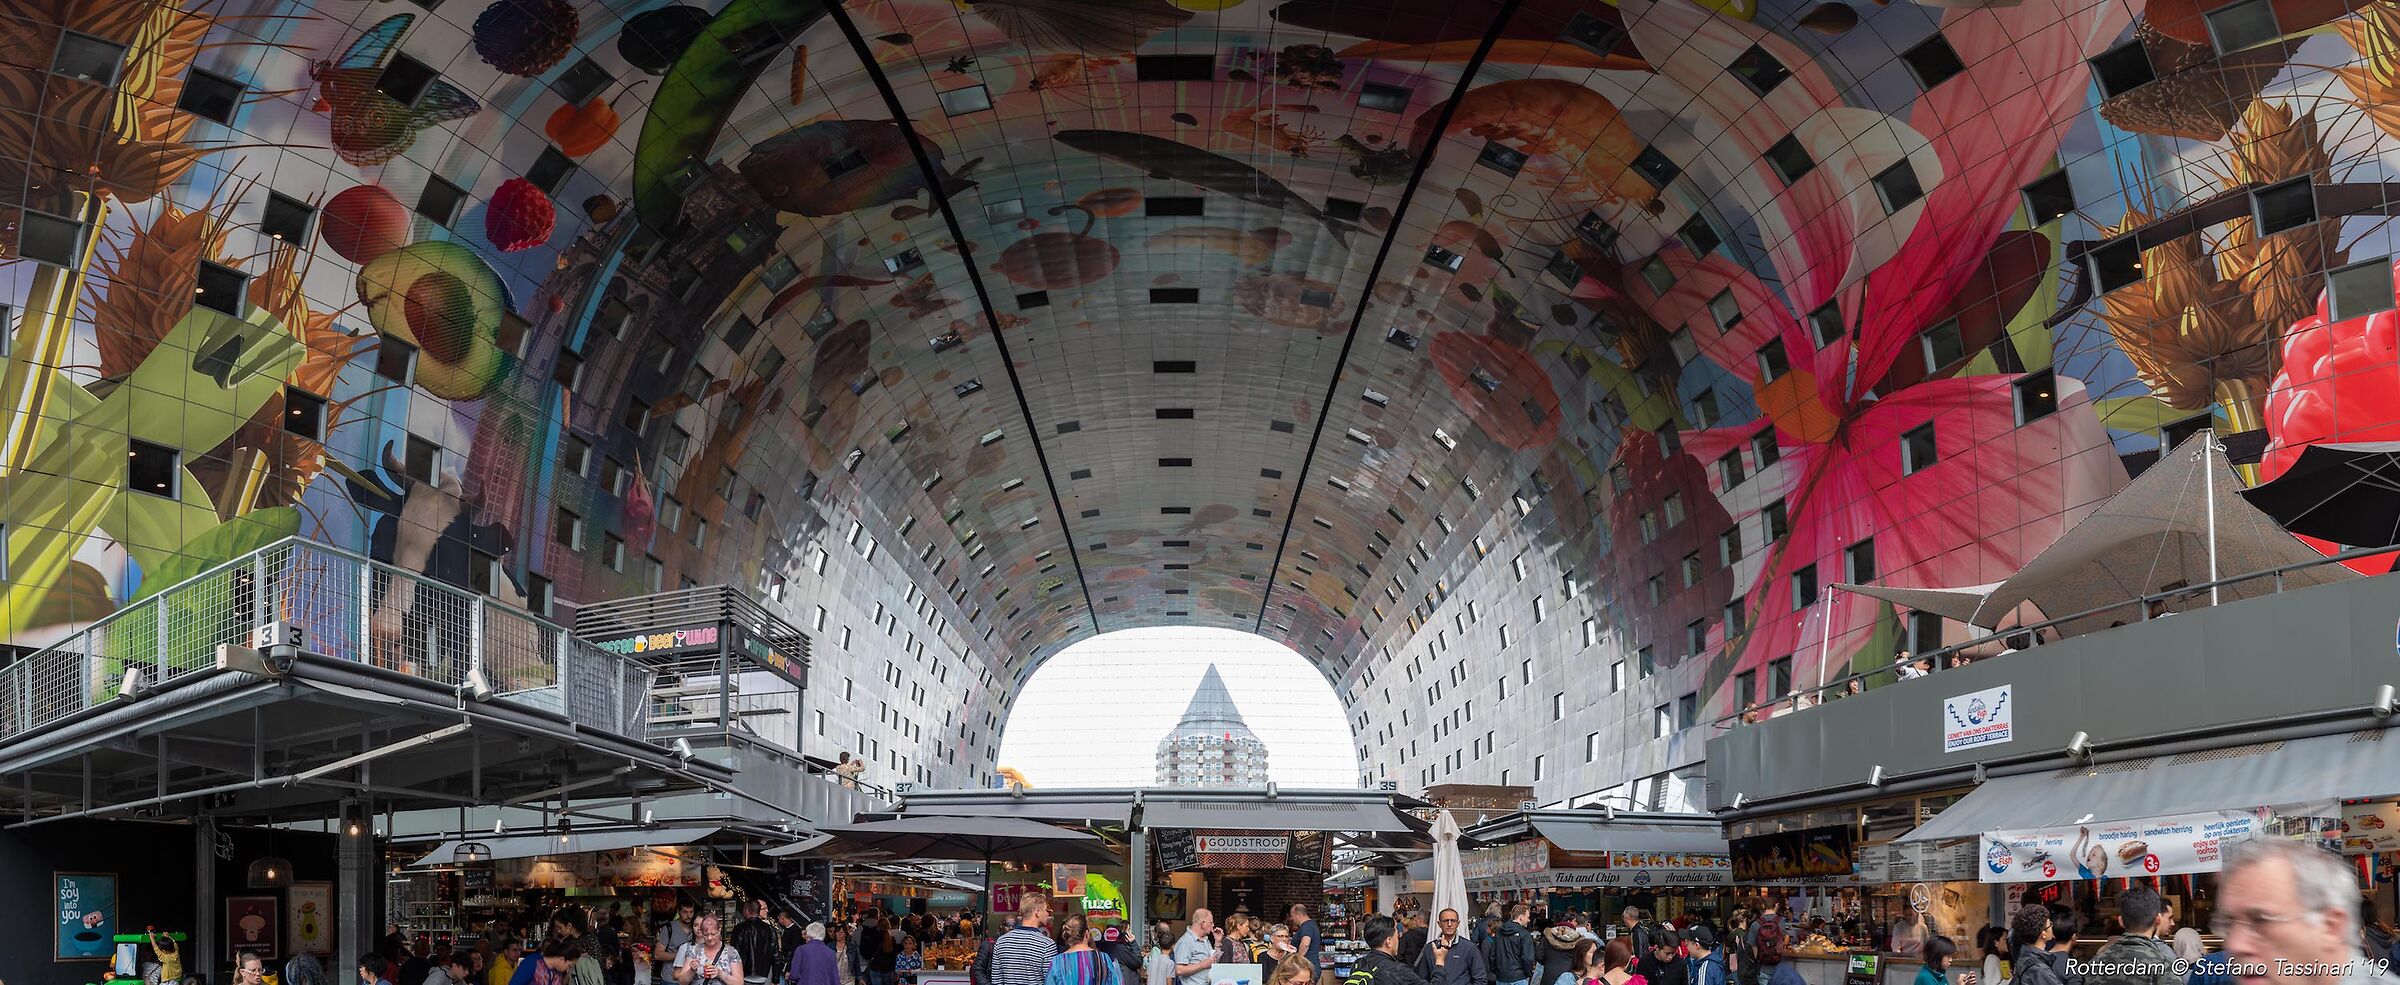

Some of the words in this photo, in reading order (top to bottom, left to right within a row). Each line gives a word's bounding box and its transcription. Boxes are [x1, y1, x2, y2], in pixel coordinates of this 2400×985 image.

[262, 626, 271, 646] 3
[290, 626, 302, 646] 3
[1948, 731, 1962, 739] GENIET
[1982, 722, 2008, 732] DAKTERRAS
[1948, 739, 1962, 747] ENJOY
[1987, 731, 2008, 740] TERRACE
[896, 783, 912, 792] 37
[1380, 782, 1397, 790] 39
[2203, 821, 2225, 831] heerlijk
[2225, 818, 2250, 829] genieten
[2099, 832, 2119, 840] broodje
[2120, 830, 2137, 839] haring
[2144, 826, 2171, 836] sandwich
[2172, 826, 2192, 834] herring
[2213, 830, 2222, 838] ons
[2223, 826, 2249, 836] dakterras
[1209, 838, 1286, 847] GOUDSTROOP
[2193, 840, 2208, 850] enjoy
[2196, 847, 2218, 856] rooftop
[1999, 855, 2012, 866] Fish
[2199, 854, 2218, 863] terrace
[1555, 873, 1573, 883] Fish
[1576, 872, 1593, 882] and
[1596, 871, 1620, 885] Chips
[1666, 872, 1703, 883] Arachide
[1706, 872, 1723, 882] Olie
[63, 879, 75, 888] I'm
[61, 888, 79, 902] soy
[62, 911, 80, 924] you
